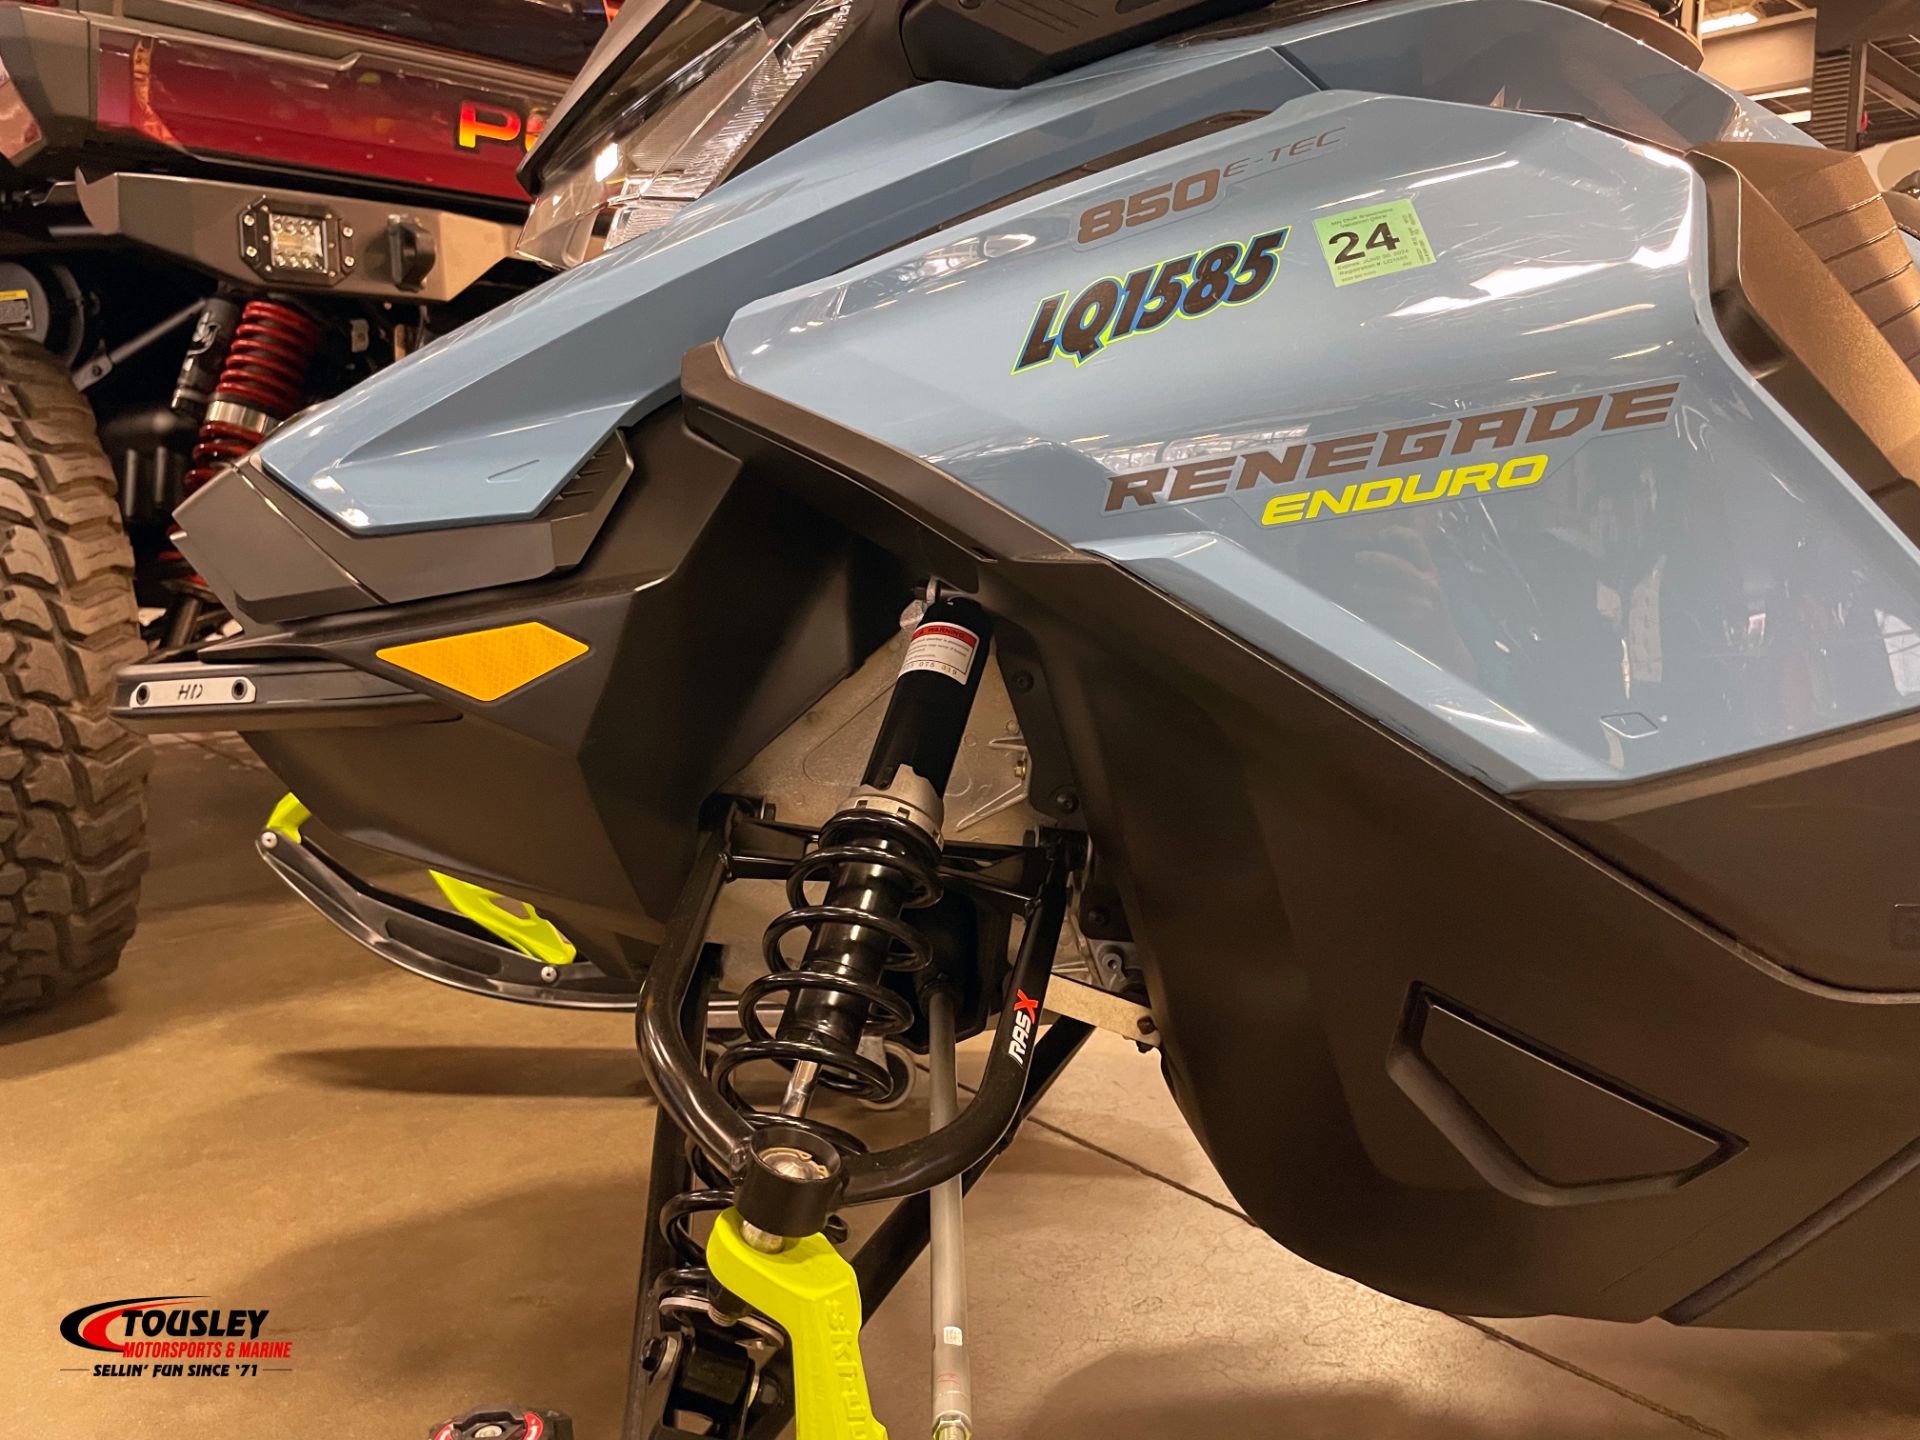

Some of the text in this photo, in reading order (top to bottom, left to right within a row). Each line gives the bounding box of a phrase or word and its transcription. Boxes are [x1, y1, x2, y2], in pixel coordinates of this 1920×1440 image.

[1077, 127, 1346, 244] 850 E-TEC
[1329, 222, 1400, 264] 24
[1010, 225, 1292, 375] LQ1585
[1104, 382, 1681, 512] RENEGADE
[1261, 454, 1549, 527] ENDURO
[1008, 988, 1039, 1066] RASX
